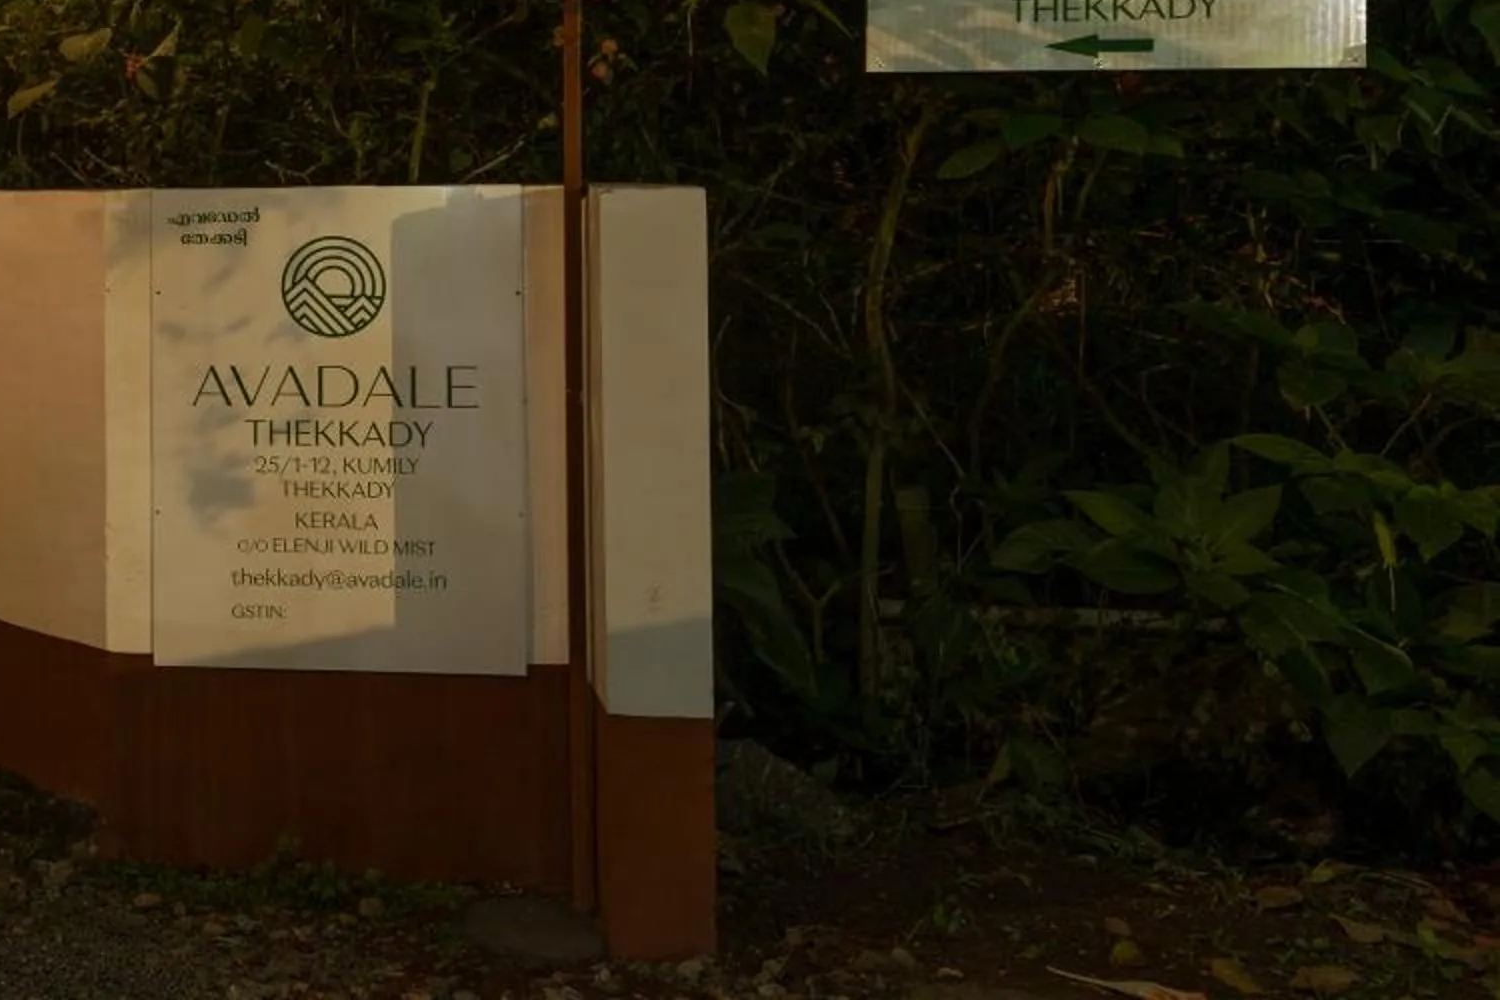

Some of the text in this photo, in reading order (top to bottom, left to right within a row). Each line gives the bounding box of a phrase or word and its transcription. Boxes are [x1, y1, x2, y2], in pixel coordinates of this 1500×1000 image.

[192, 365, 480, 409] AVADALE
[244, 418, 434, 448] THEKKADY
[255, 455, 419, 476] 25/1-12, KUMILY
[282, 480, 395, 499] THEKKADY
[295, 512, 379, 531] KERALA
[237, 537, 436, 557] C/O ELENJI WILD MIST
[231, 568, 448, 591] thekkady@avadale.in
[231, 604, 288, 619] GSTIN:
